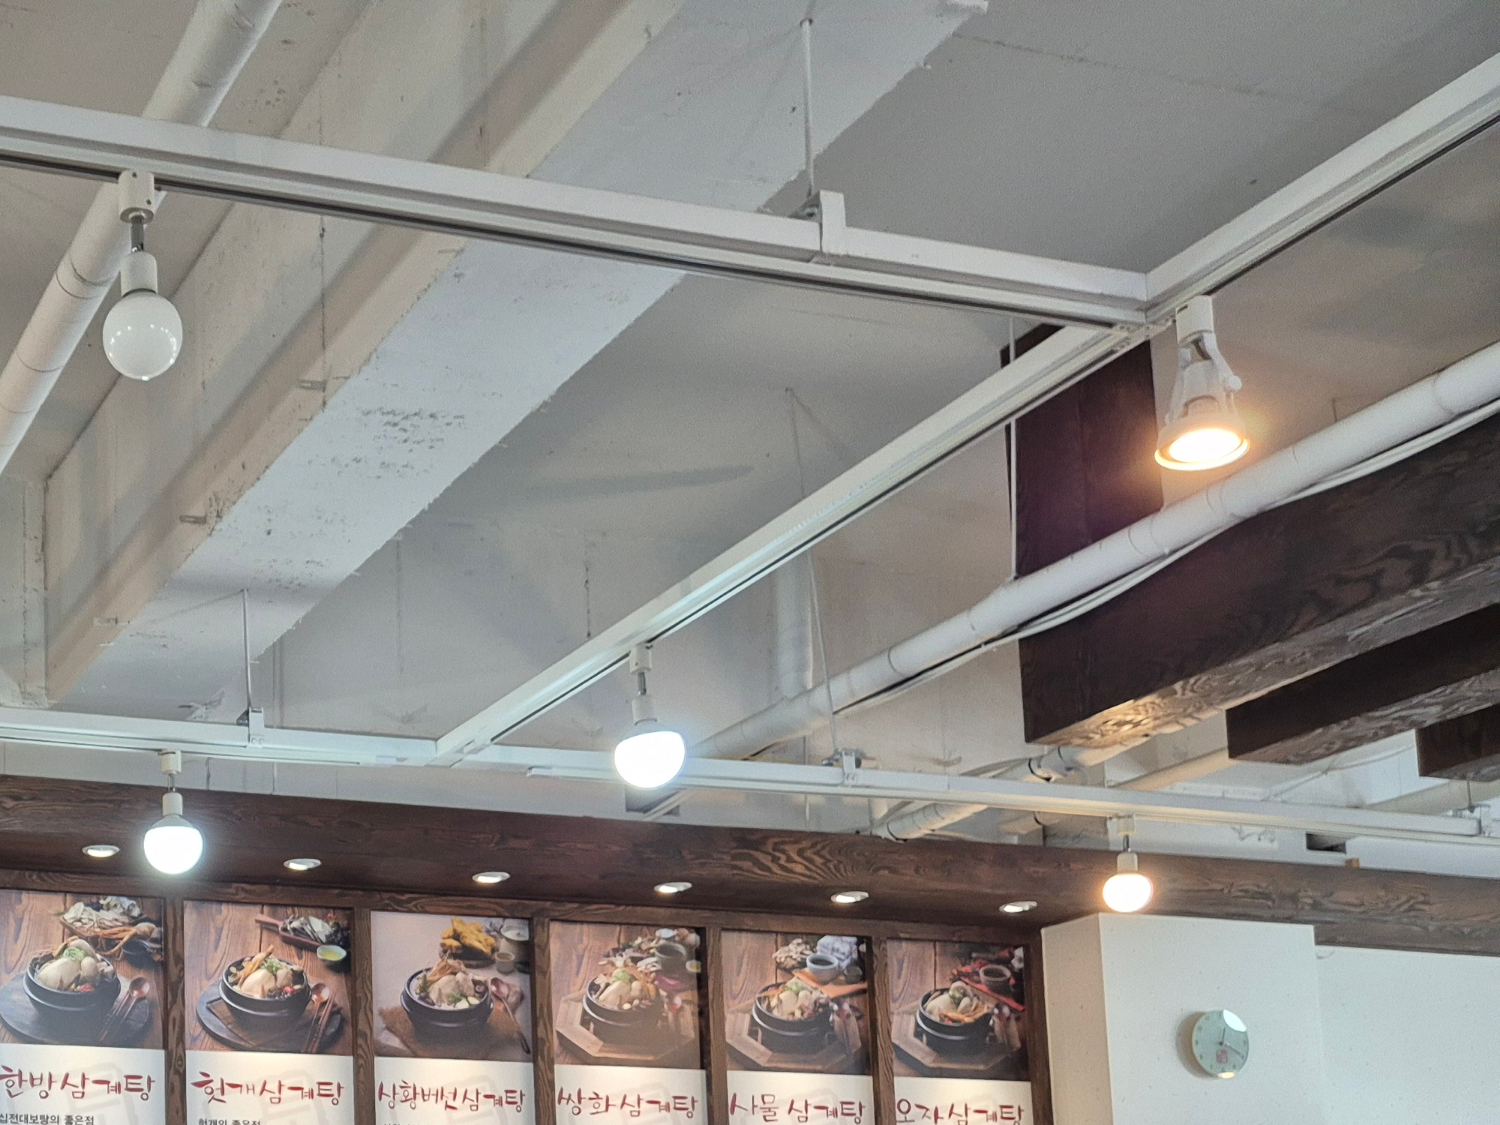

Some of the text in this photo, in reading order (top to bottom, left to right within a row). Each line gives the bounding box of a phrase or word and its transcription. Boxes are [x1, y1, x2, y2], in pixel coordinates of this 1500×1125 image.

[190, 1070, 345, 1106] 헛개삼계탕
[557, 1086, 698, 1118] 쌍화삼계탕
[0, 1114, 95, 1125] 십전대보탕의 좋은점
[729, 1092, 866, 1125] 사물삼계탕
